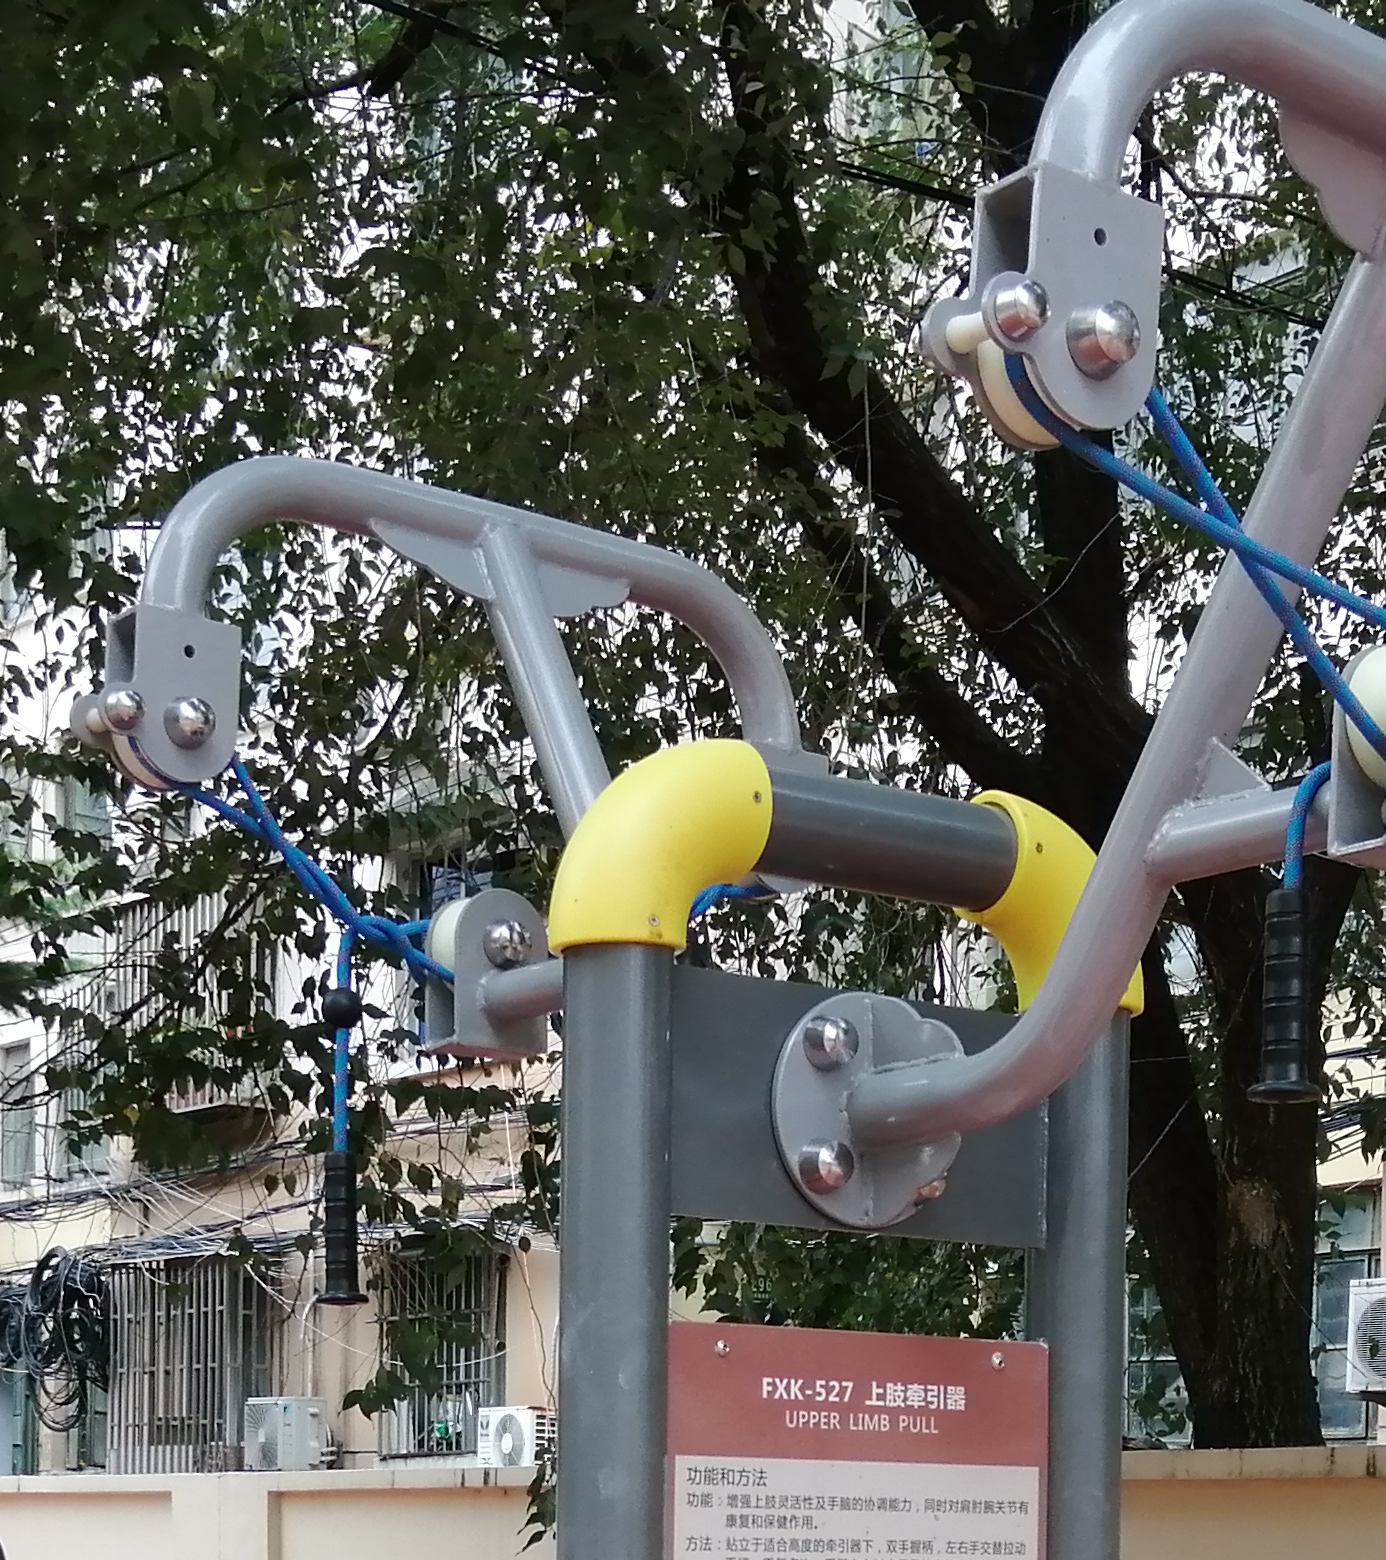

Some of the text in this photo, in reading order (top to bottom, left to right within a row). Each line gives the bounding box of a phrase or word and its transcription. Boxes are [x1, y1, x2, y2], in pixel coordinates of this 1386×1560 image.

[762, 1377, 965, 1410] FXK-527 上肢牵引器
[785, 1410, 938, 1433] UPPER LIMB PULL
[686, 1465, 767, 1487] 功能和方法
